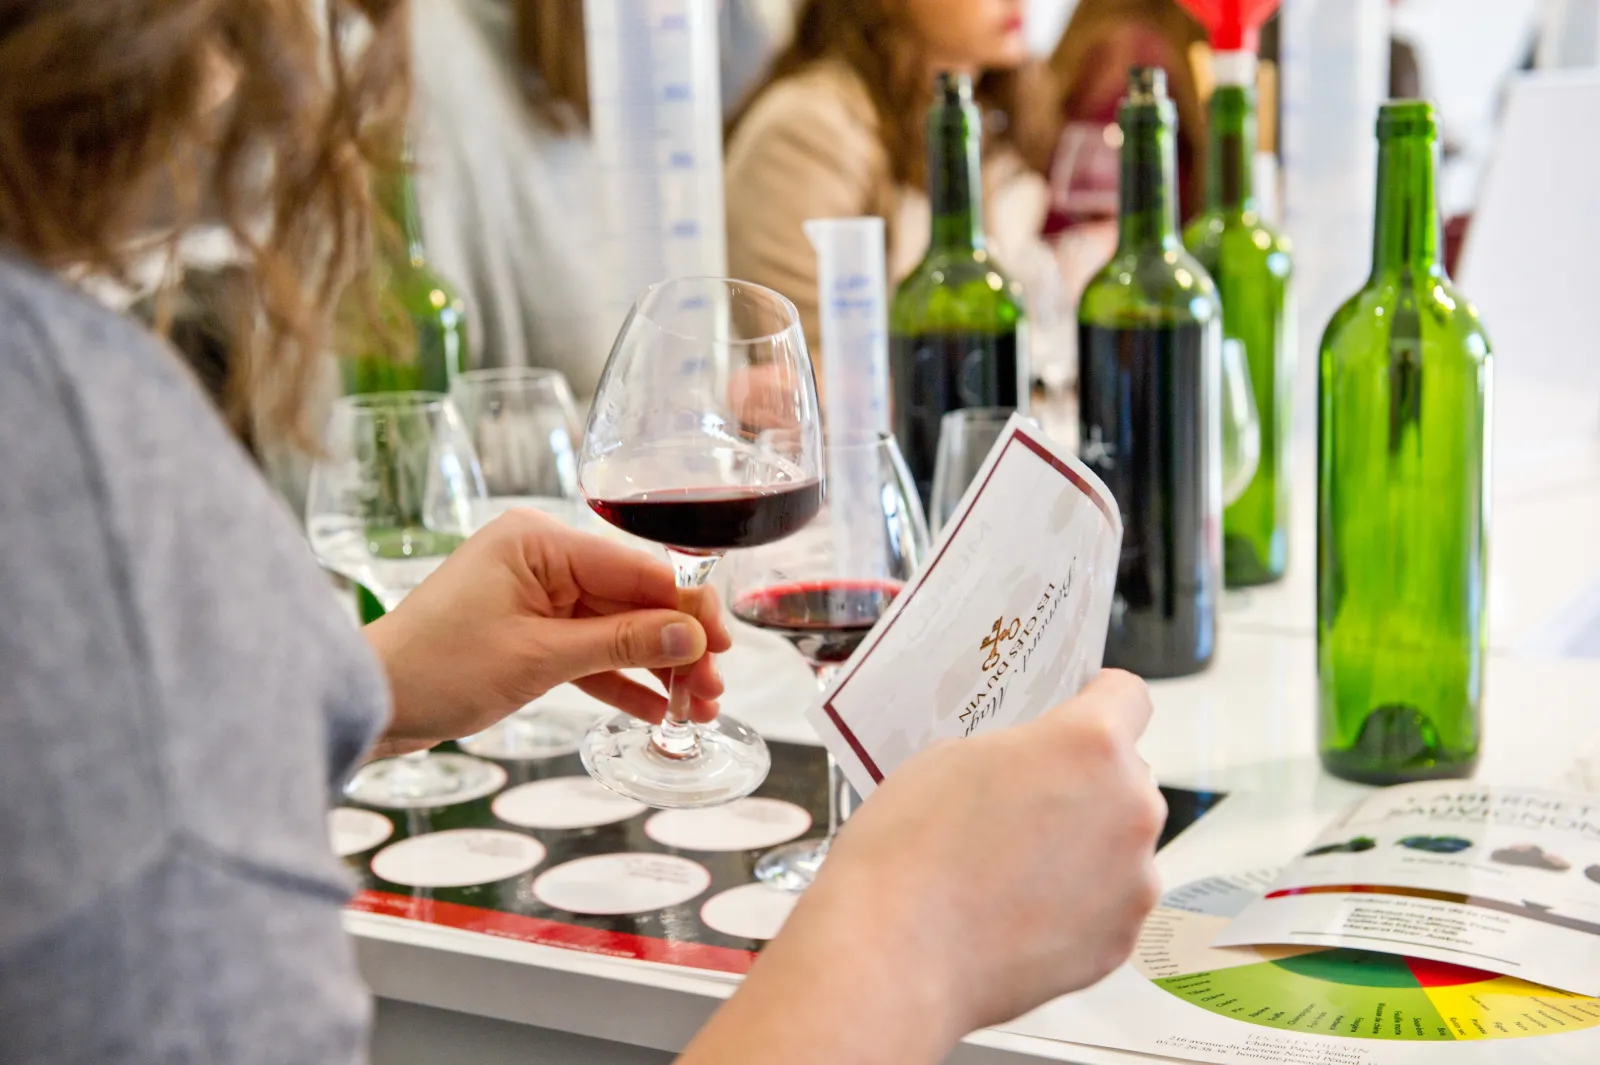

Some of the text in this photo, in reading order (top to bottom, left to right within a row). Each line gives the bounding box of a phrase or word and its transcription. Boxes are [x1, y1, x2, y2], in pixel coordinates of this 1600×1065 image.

[1036, 582, 1056, 613] LES
[958, 556, 1077, 739] Bernard Magr
[987, 661, 1009, 689] DU
[958, 691, 988, 723] VIN
[1189, 1040, 1224, 1048] avenue
[1241, 1046, 1281, 1055] docteur
